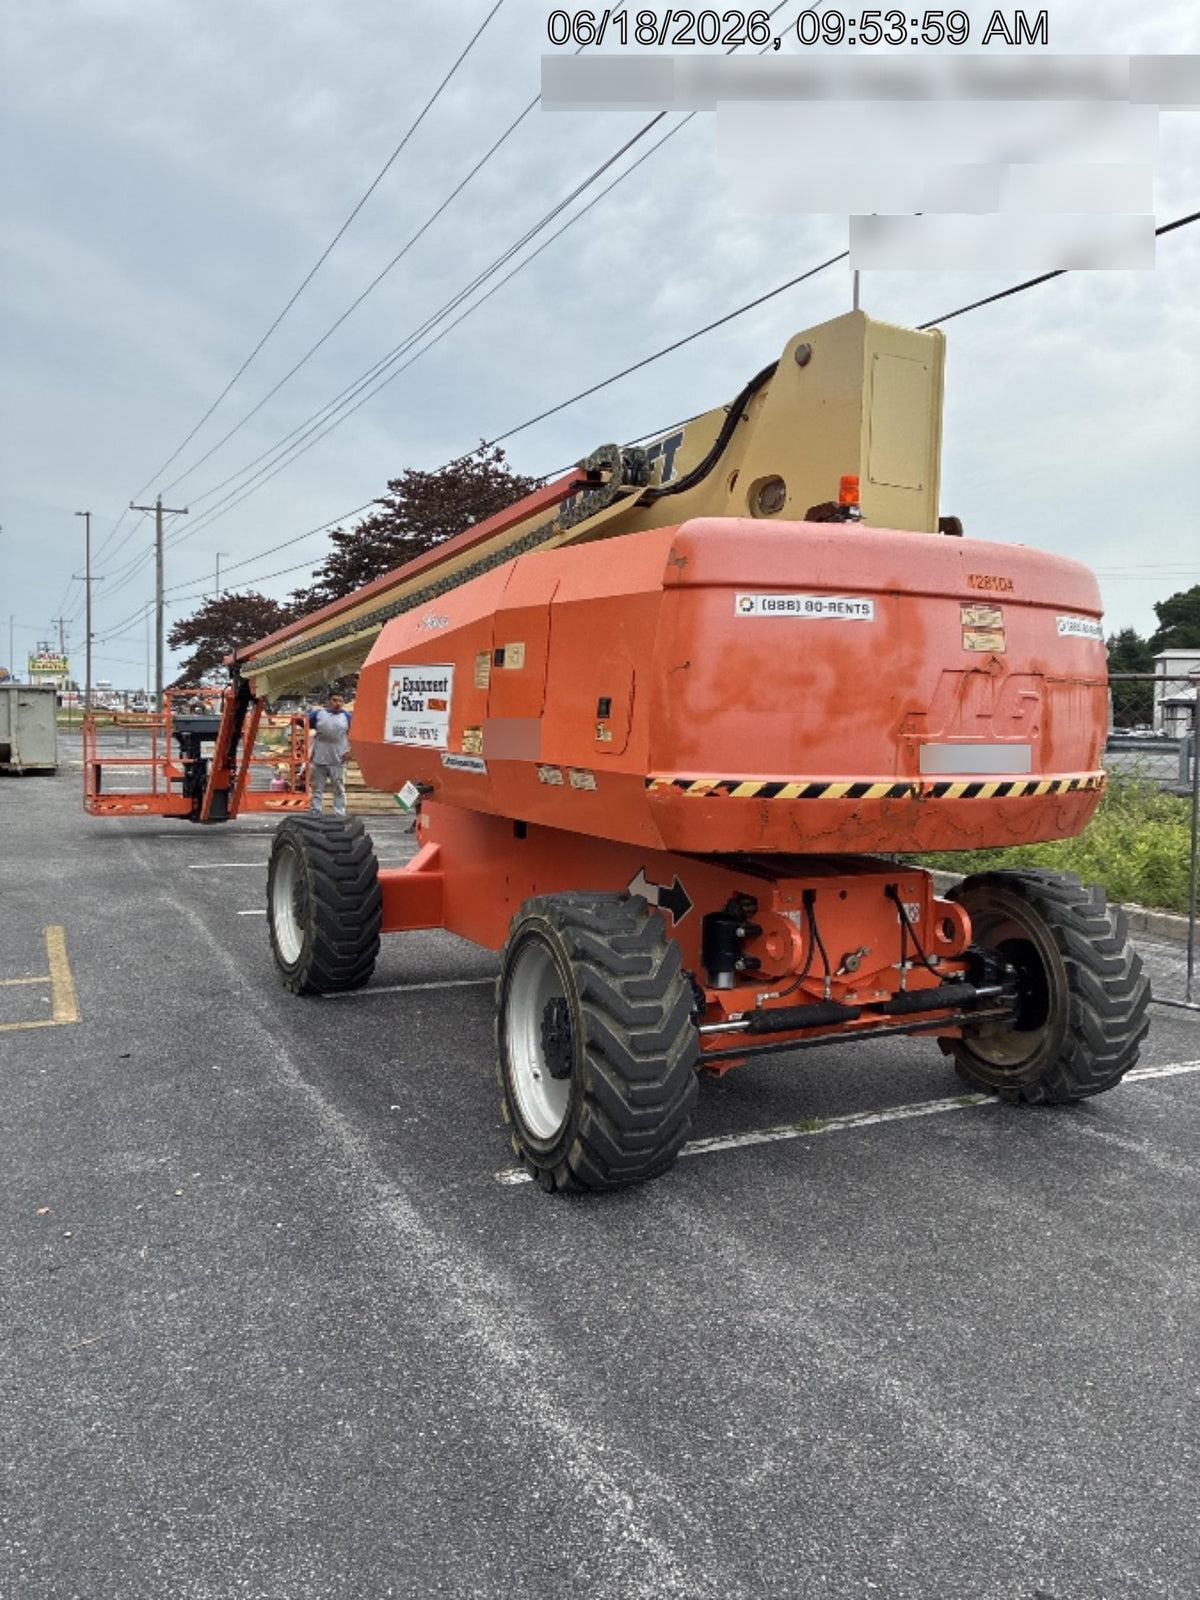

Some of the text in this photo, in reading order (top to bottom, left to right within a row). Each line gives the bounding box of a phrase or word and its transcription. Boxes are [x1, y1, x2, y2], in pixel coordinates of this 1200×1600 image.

[762, 598, 870, 615] (888) 80-RENTS
[403, 677, 448, 696] Equipment
[401, 695, 424, 712] Share
